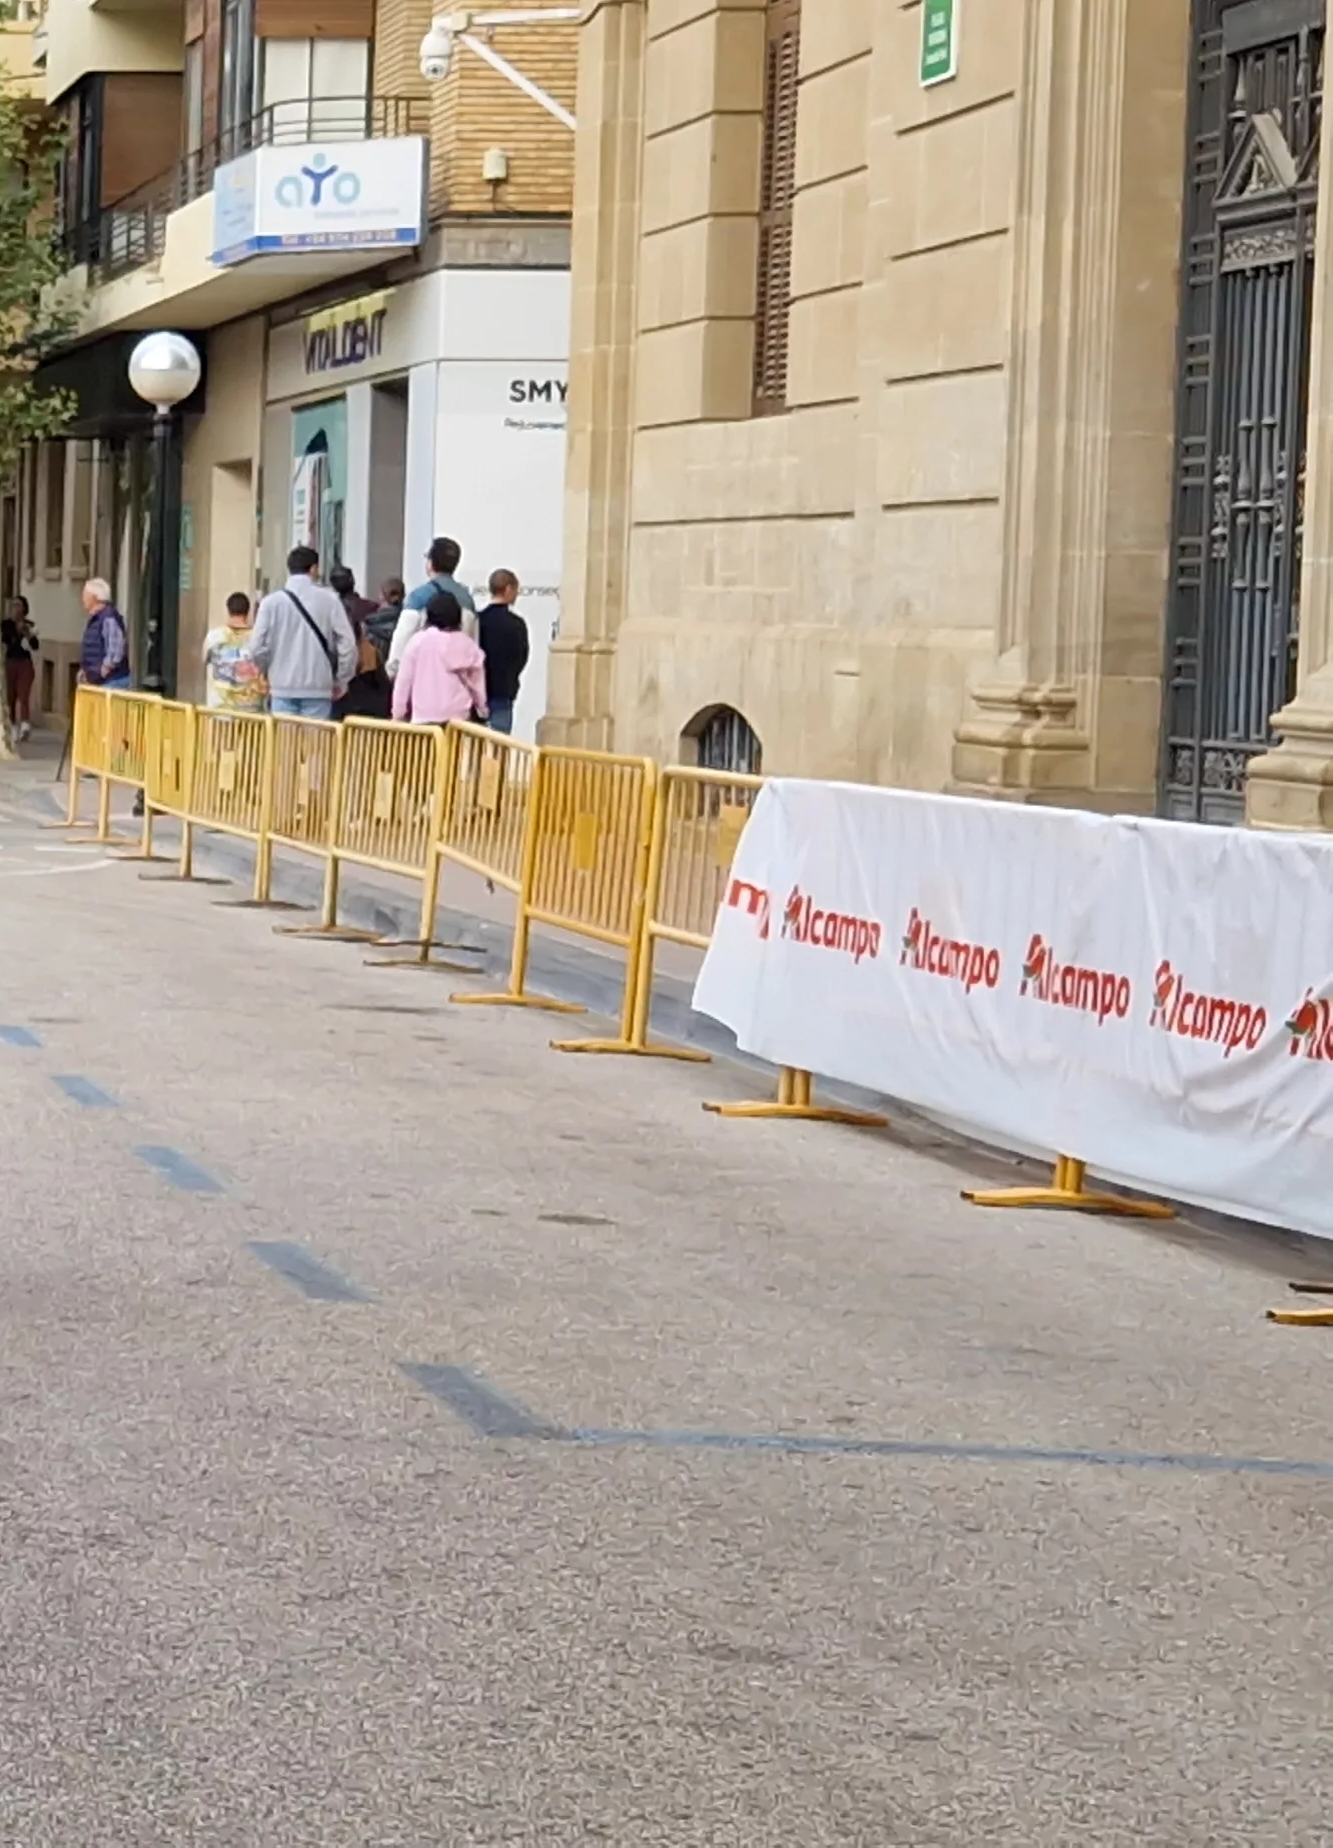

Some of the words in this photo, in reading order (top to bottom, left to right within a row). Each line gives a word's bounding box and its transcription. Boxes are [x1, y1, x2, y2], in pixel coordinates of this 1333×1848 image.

[303, 307, 387, 375] VITALDENT
[781, 884, 881, 965] Alcampo
[900, 907, 1000, 995] Alcampo
[1019, 934, 1130, 1027] Alcampo
[1149, 959, 1267, 1059] Alcampo
